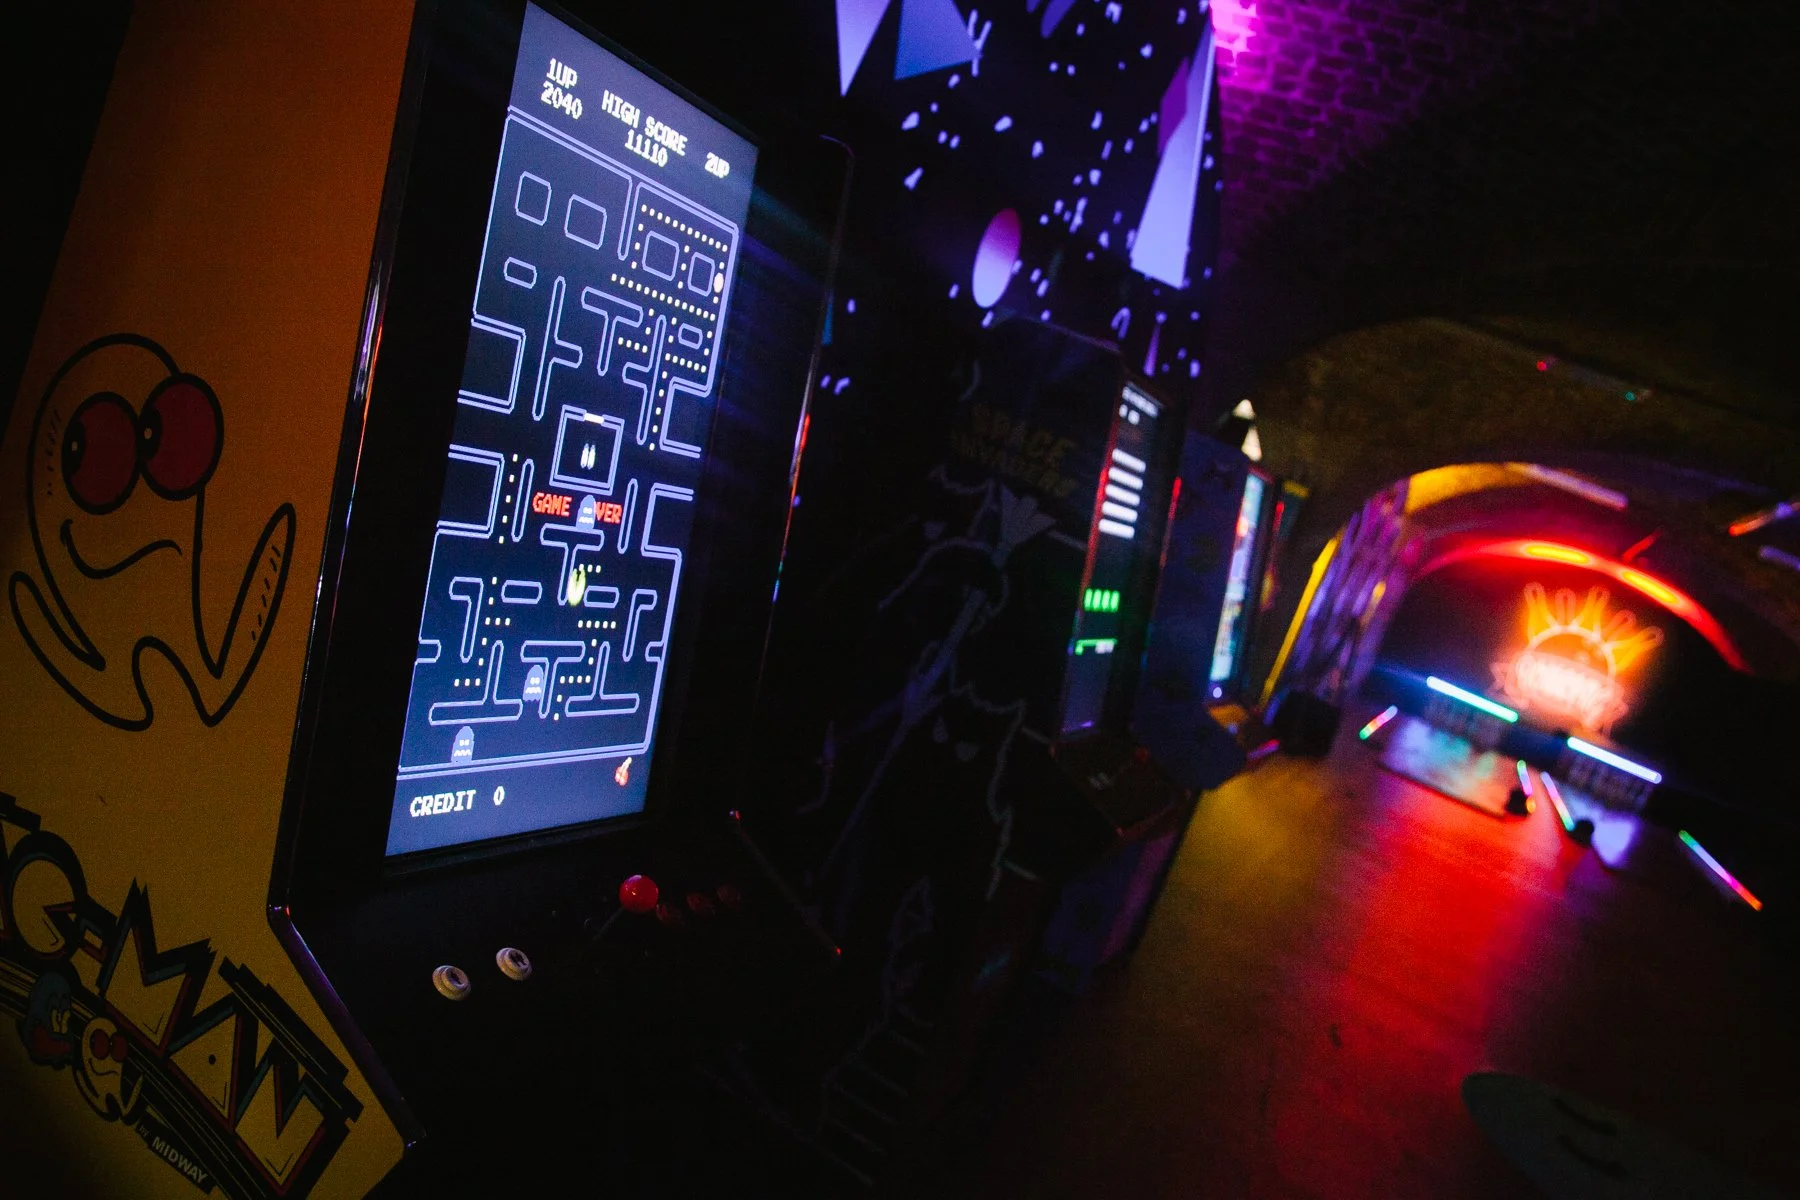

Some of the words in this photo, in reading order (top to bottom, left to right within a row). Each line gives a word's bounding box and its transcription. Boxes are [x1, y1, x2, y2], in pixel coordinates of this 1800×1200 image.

[546, 58, 578, 88] 1UP
[541, 81, 583, 120] 2040
[602, 89, 640, 128] HIGH
[645, 116, 688, 156] SCORE
[624, 130, 668, 167] 11110
[704, 152, 730, 178] 2UP
[532, 491, 572, 517] GAME
[593, 501, 623, 524] VER
[409, 789, 477, 817] CREDIT
[493, 785, 506, 806] 0
[152, 1136, 208, 1183] MIDWAY
